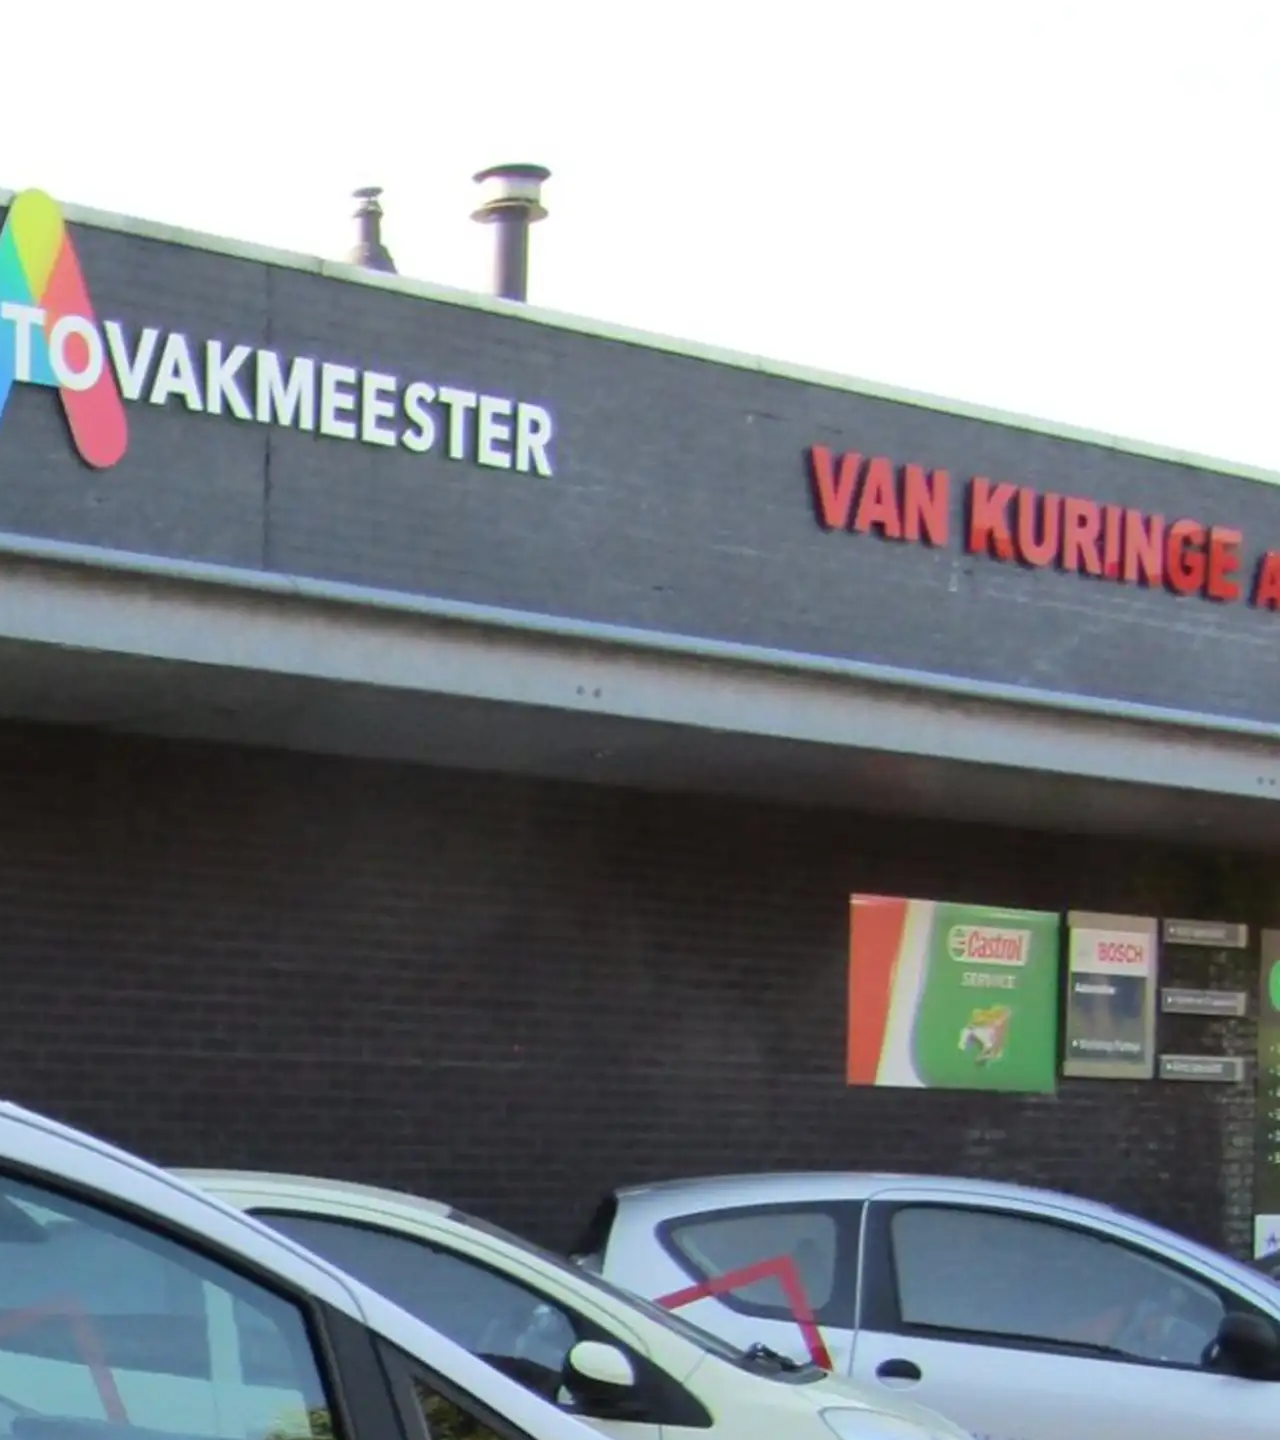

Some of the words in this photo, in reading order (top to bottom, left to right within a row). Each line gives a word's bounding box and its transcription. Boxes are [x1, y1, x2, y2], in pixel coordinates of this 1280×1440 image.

[808, 444, 951, 548] VAN
[966, 476, 1244, 602] KURINGE
[967, 929, 1023, 962] Castrol
[1097, 940, 1144, 964] BOSCH
